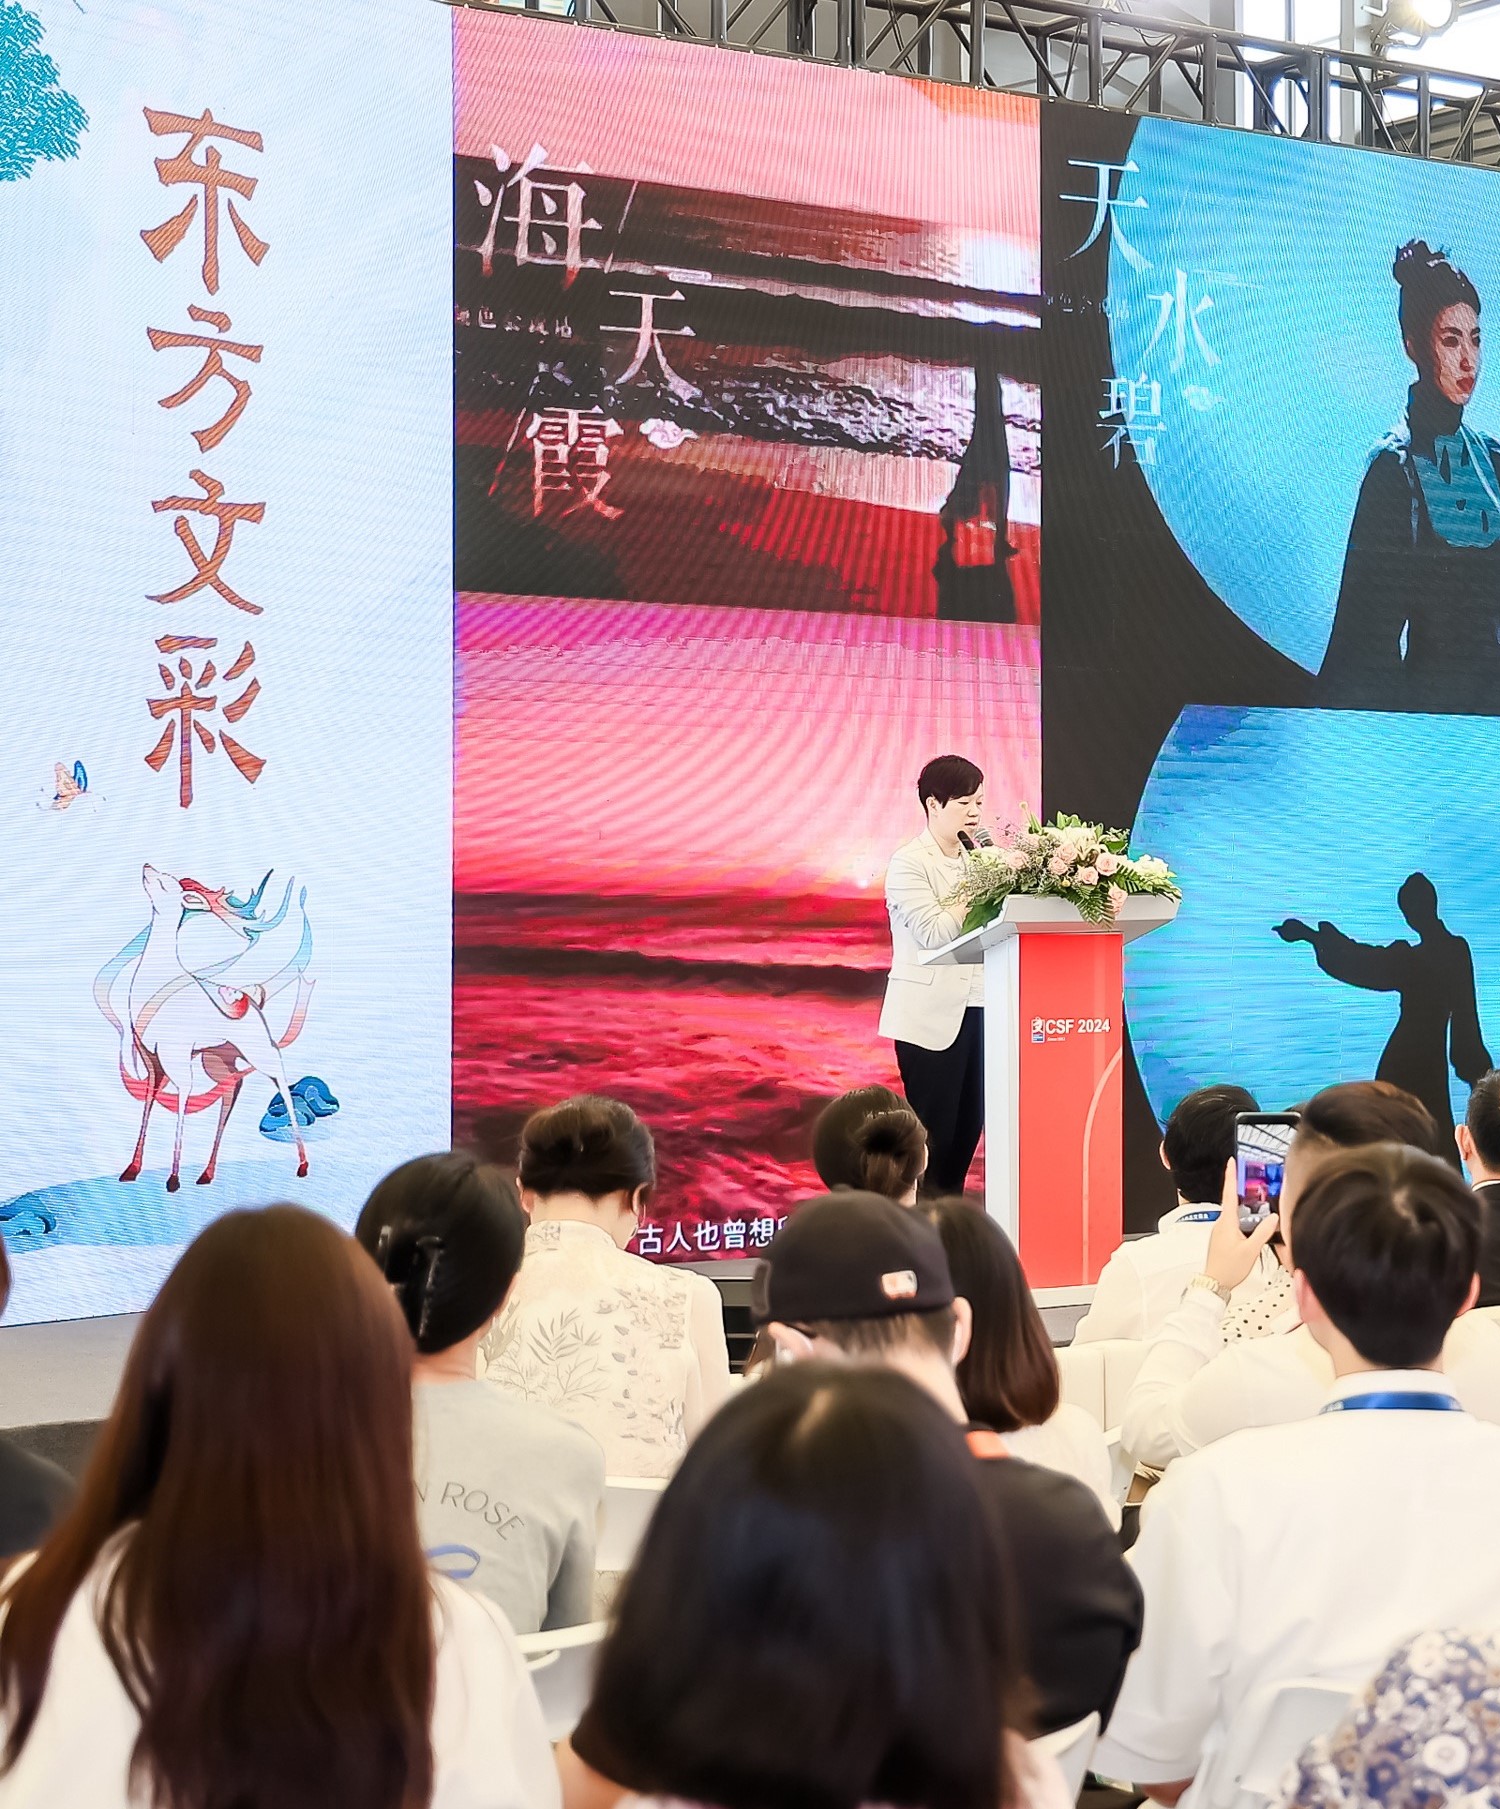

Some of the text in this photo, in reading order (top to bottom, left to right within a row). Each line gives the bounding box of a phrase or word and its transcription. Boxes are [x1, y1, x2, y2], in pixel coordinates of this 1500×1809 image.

[140, 105, 270, 810] 东方文彩
[1045, 1019, 1075, 1034] CSF
[1077, 1018, 1111, 1033] 2024
[637, 1215, 788, 1255] 古人也曾想
[440, 1481, 525, 1541] ROSE
